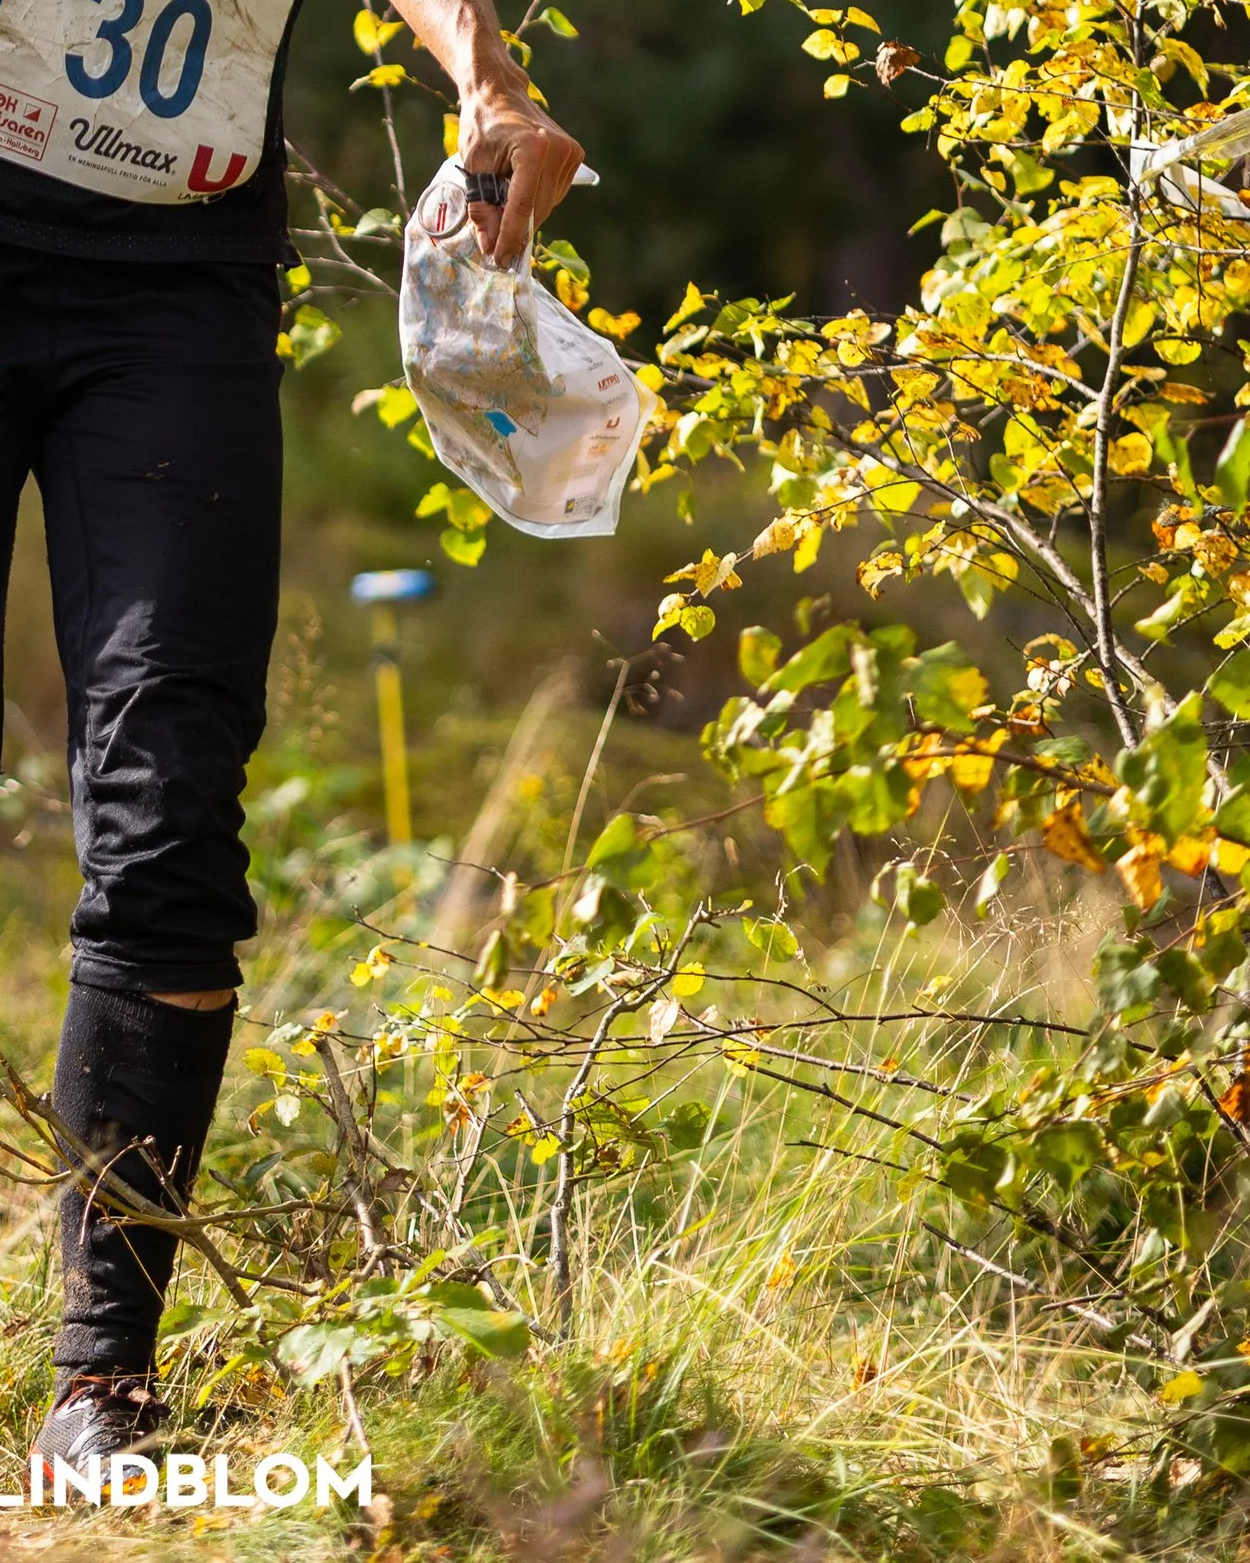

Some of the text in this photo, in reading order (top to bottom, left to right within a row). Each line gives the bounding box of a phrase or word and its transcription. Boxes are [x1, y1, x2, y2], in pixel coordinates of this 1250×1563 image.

[69, 117, 178, 174] Ullmax
[187, 143, 248, 193] U
[68, 154, 168, 188] EN MENINGSFULL FRITID FÖR ALLA
